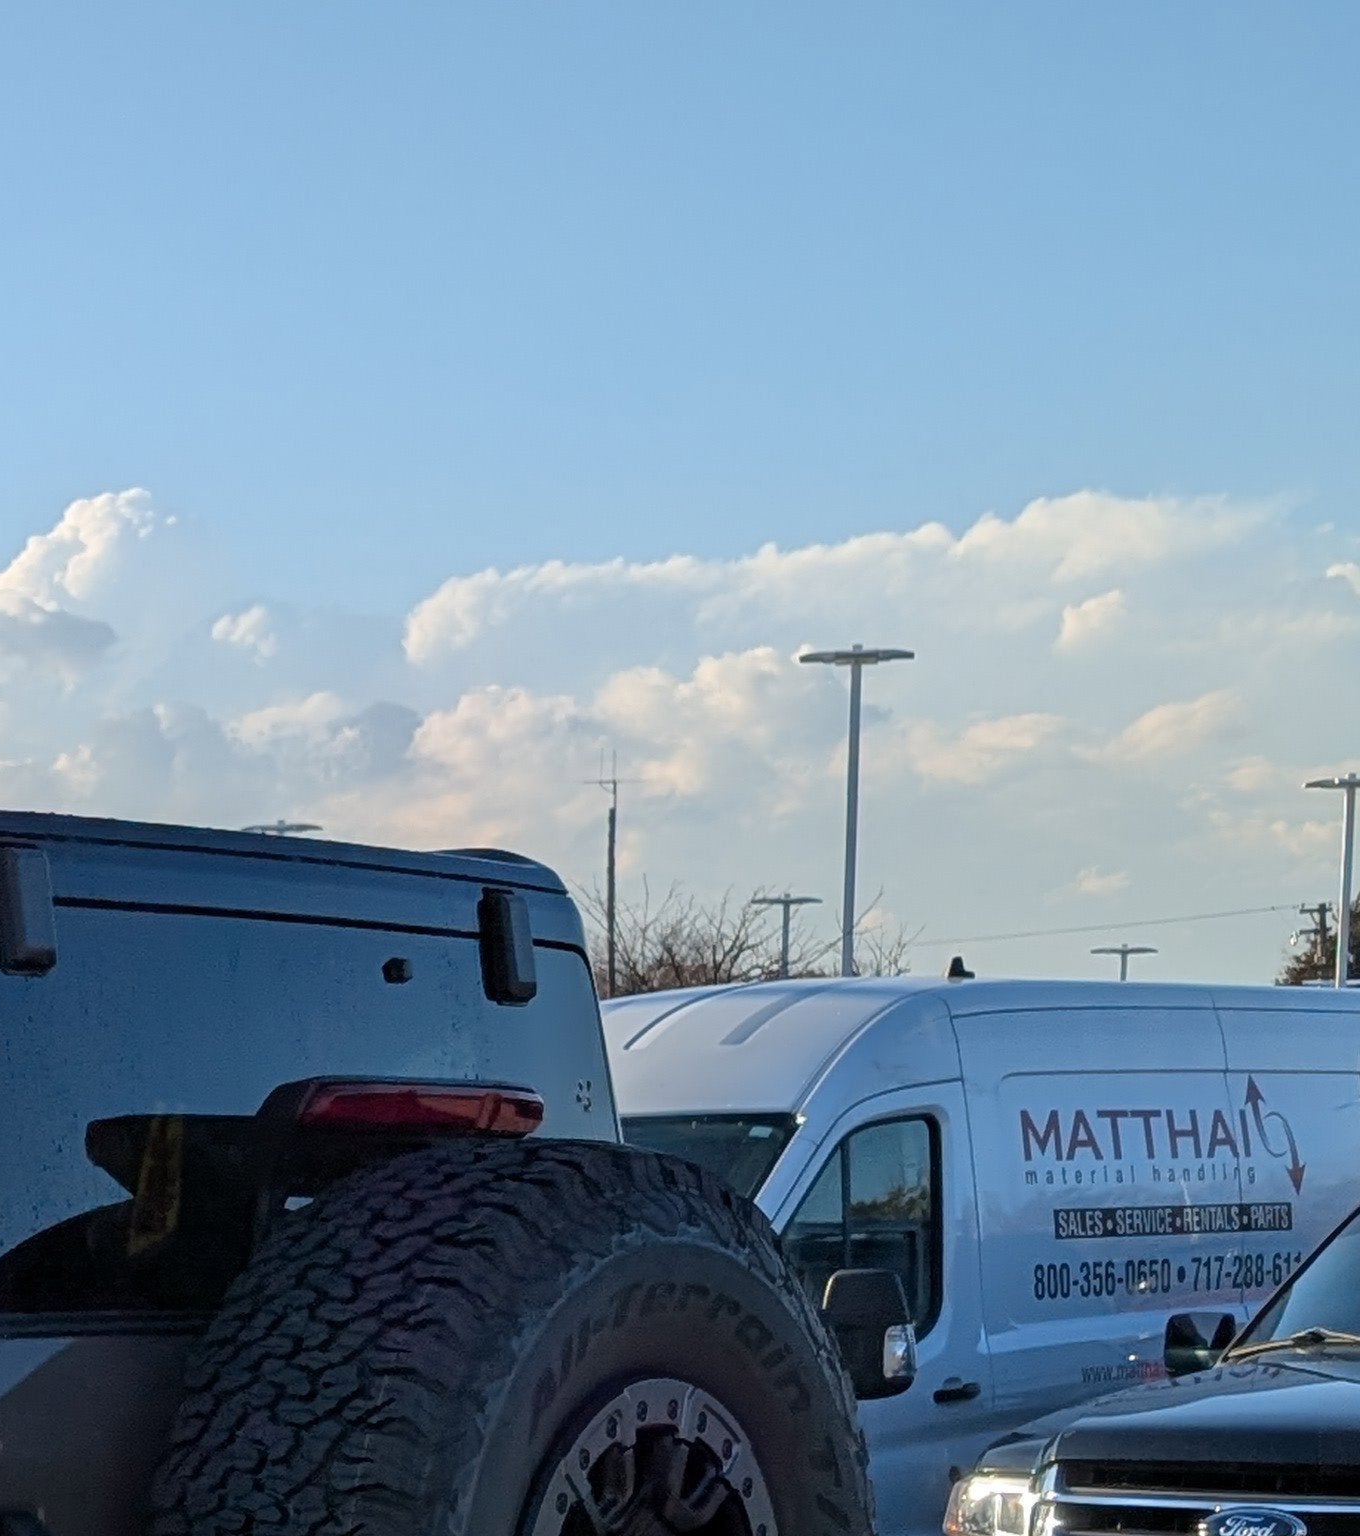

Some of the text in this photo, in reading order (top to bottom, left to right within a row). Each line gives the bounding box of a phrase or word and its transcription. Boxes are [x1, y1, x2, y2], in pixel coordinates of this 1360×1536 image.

[1019, 1109, 1251, 1162] MATTHAI
[1025, 1163, 1256, 1185] material handling
[1058, 1202, 1291, 1238] SALES SERVICE RENTALS PARTS
[1034, 1258, 1172, 1301] 800-356-0650
